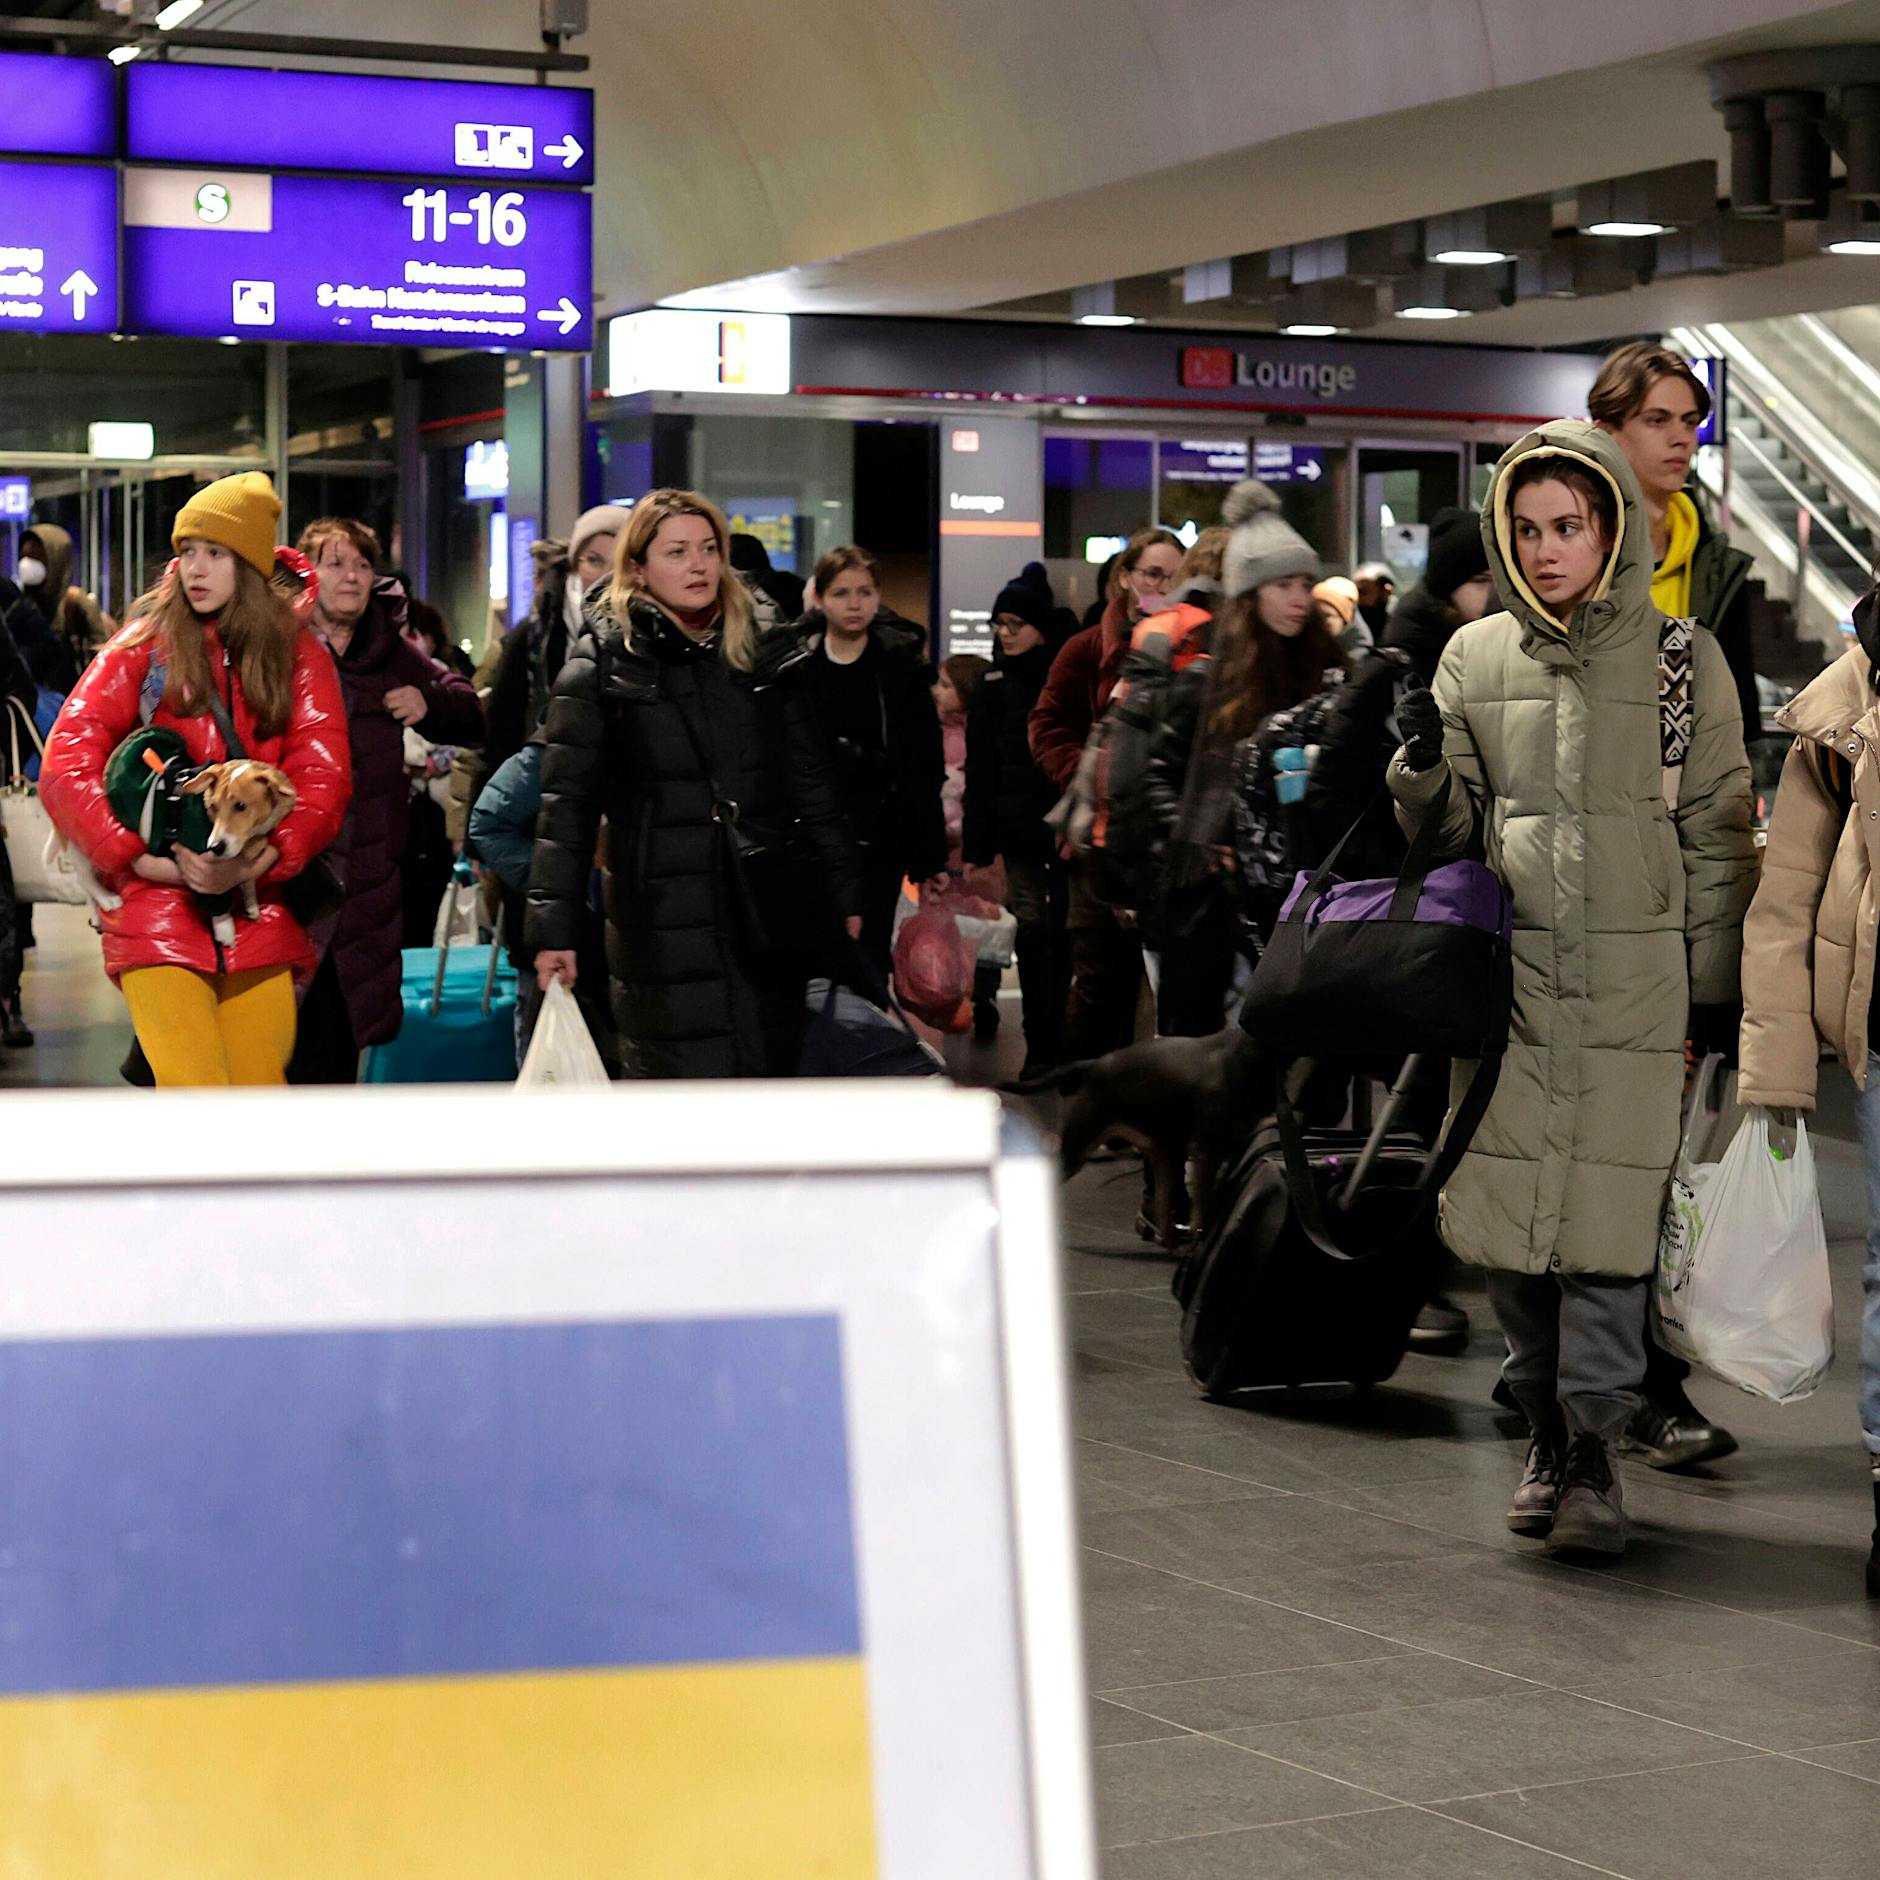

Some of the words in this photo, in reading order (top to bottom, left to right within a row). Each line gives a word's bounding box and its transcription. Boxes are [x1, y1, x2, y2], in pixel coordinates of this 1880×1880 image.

[197, 183, 229, 223] S
[402, 188, 527, 247] 11-16
[1236, 352, 1357, 397] Lounge
